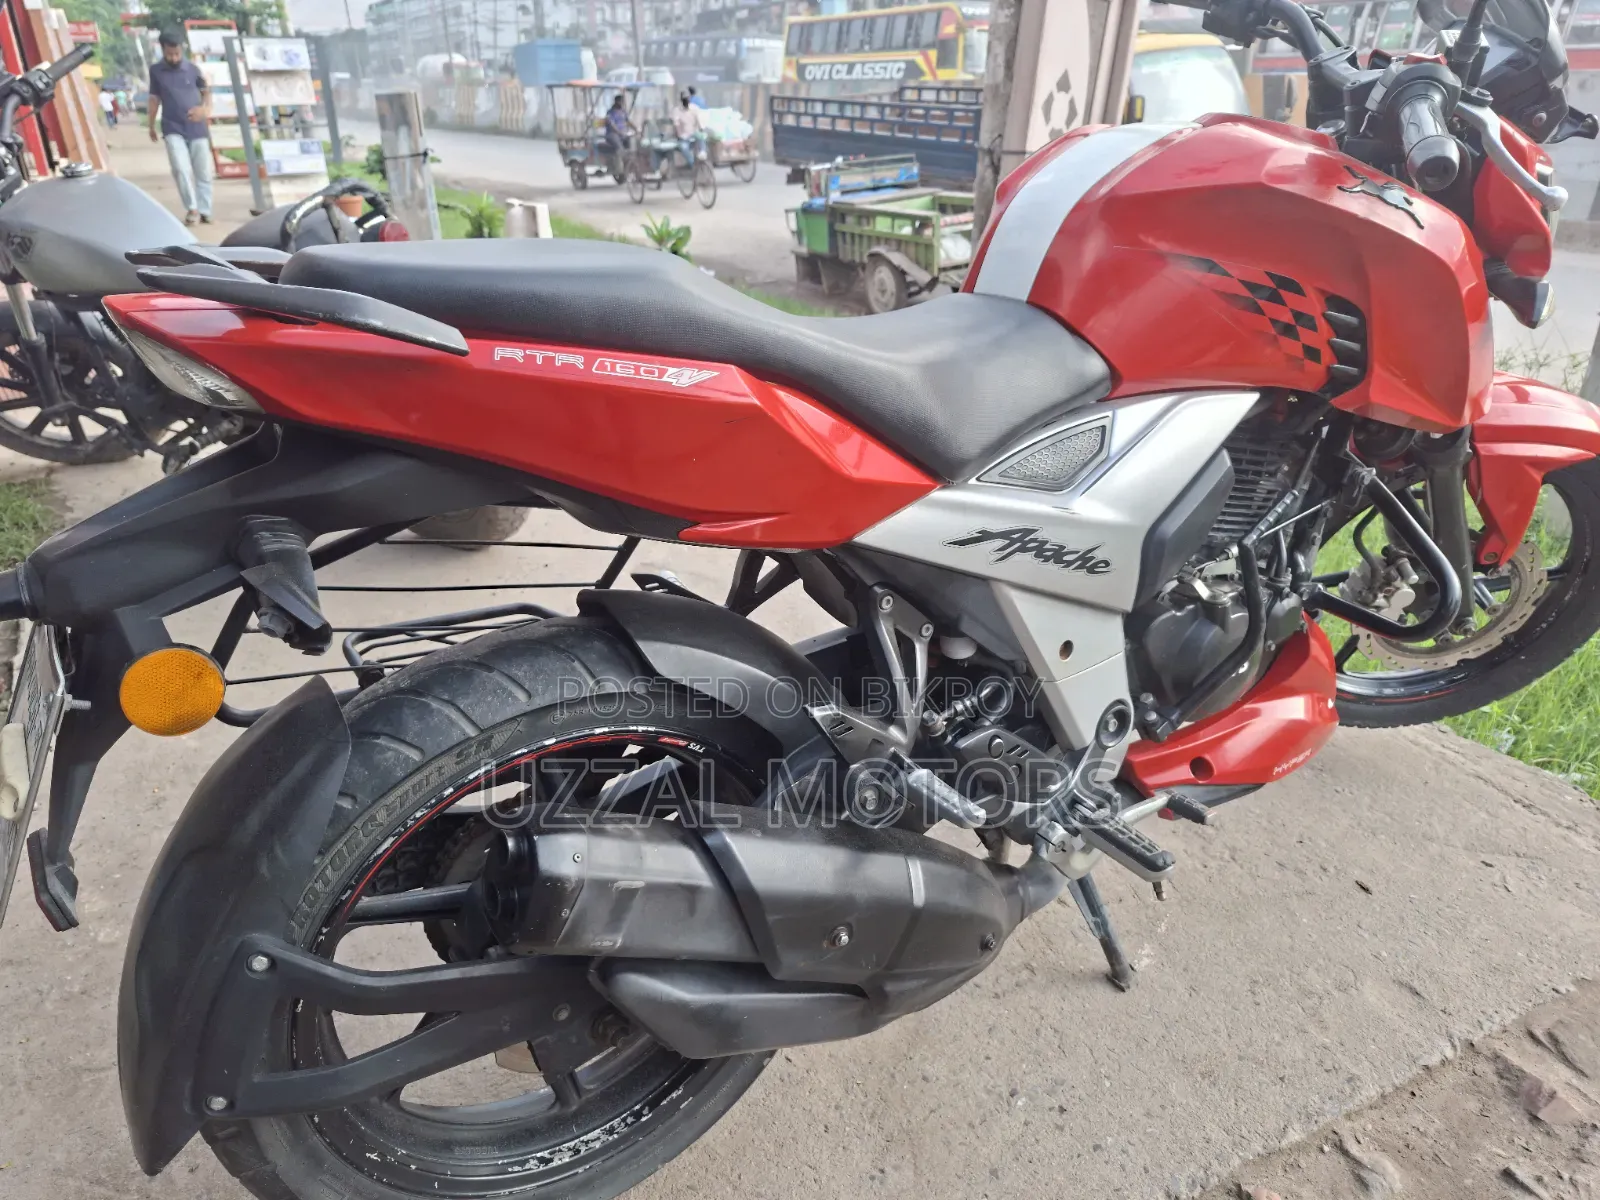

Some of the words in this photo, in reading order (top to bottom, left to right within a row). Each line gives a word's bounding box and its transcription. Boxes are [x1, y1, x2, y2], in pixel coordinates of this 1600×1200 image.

[804, 64, 831, 80] OVI
[831, 62, 906, 79] CLASSIC
[494, 347, 584, 369] RTR
[944, 526, 1114, 576] Apache
[687, 742, 706, 754] TVS
